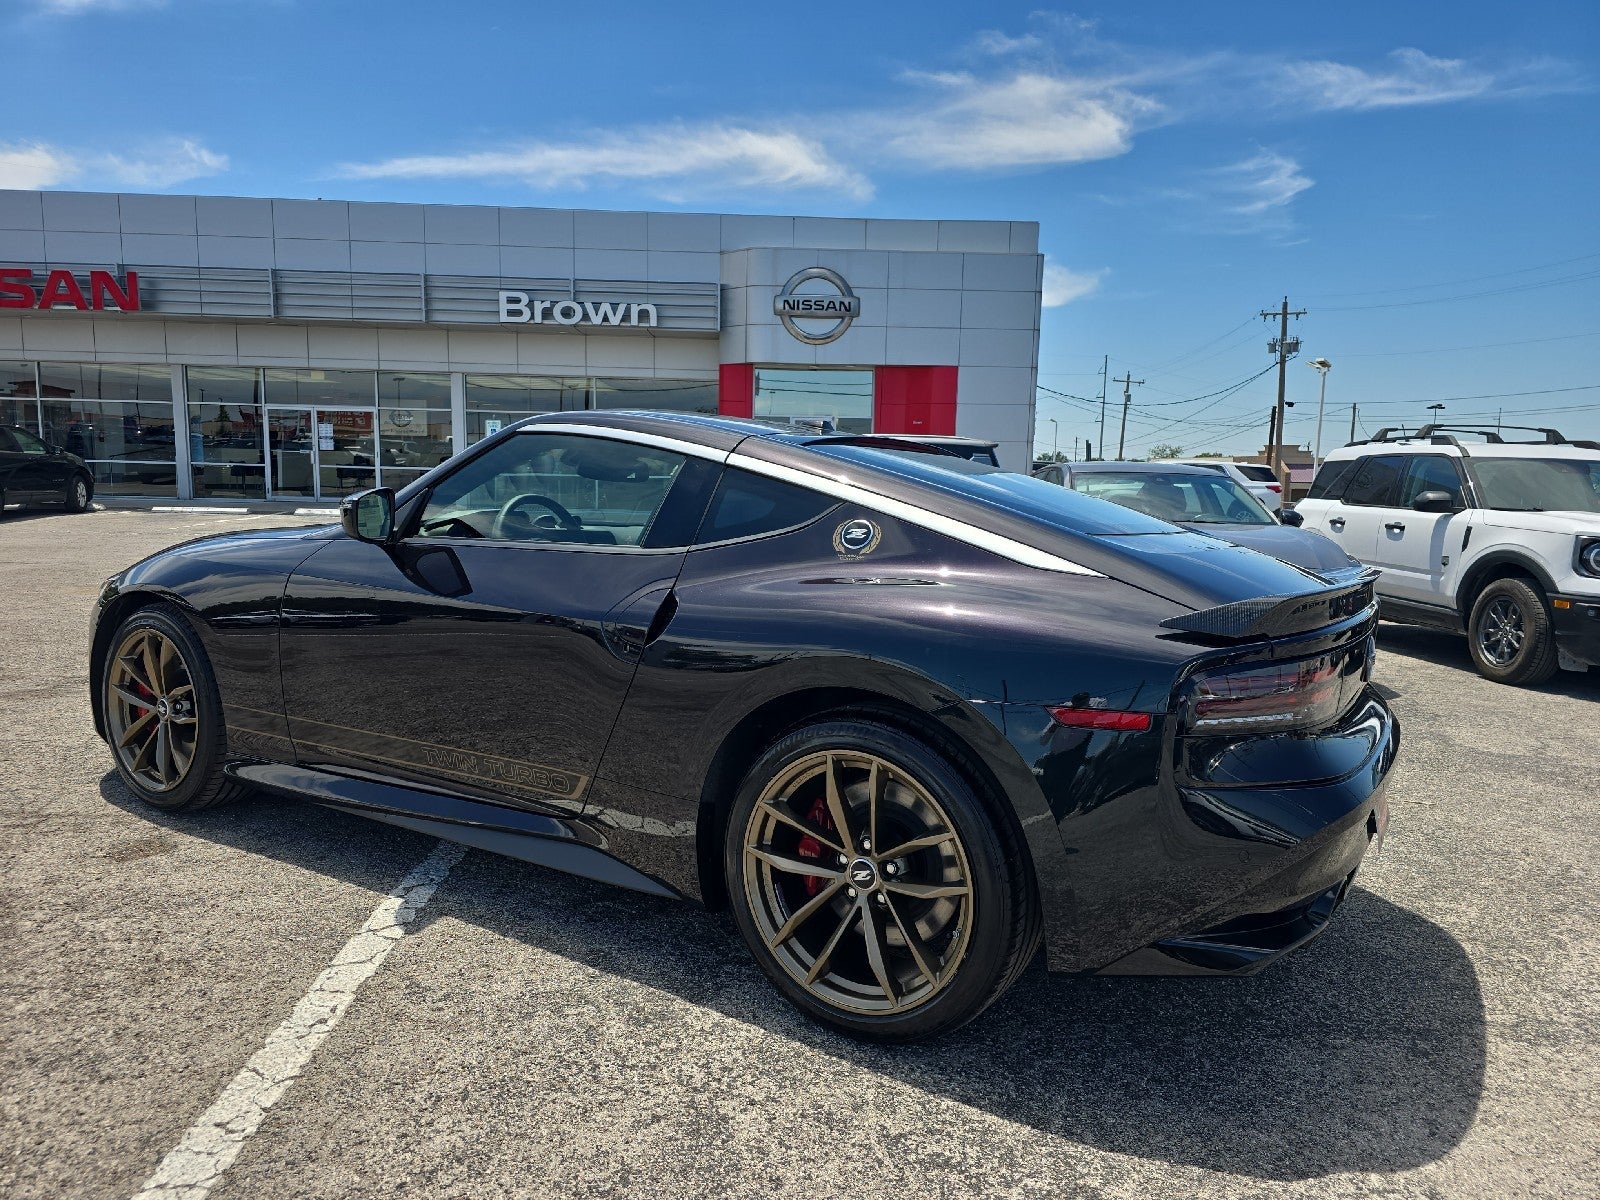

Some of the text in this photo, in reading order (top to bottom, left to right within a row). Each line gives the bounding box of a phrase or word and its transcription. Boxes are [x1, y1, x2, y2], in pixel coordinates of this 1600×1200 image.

[498, 290, 658, 327] Brown
[782, 299, 852, 313] NISSAN
[421, 746, 570, 793] TWIN TURBO
